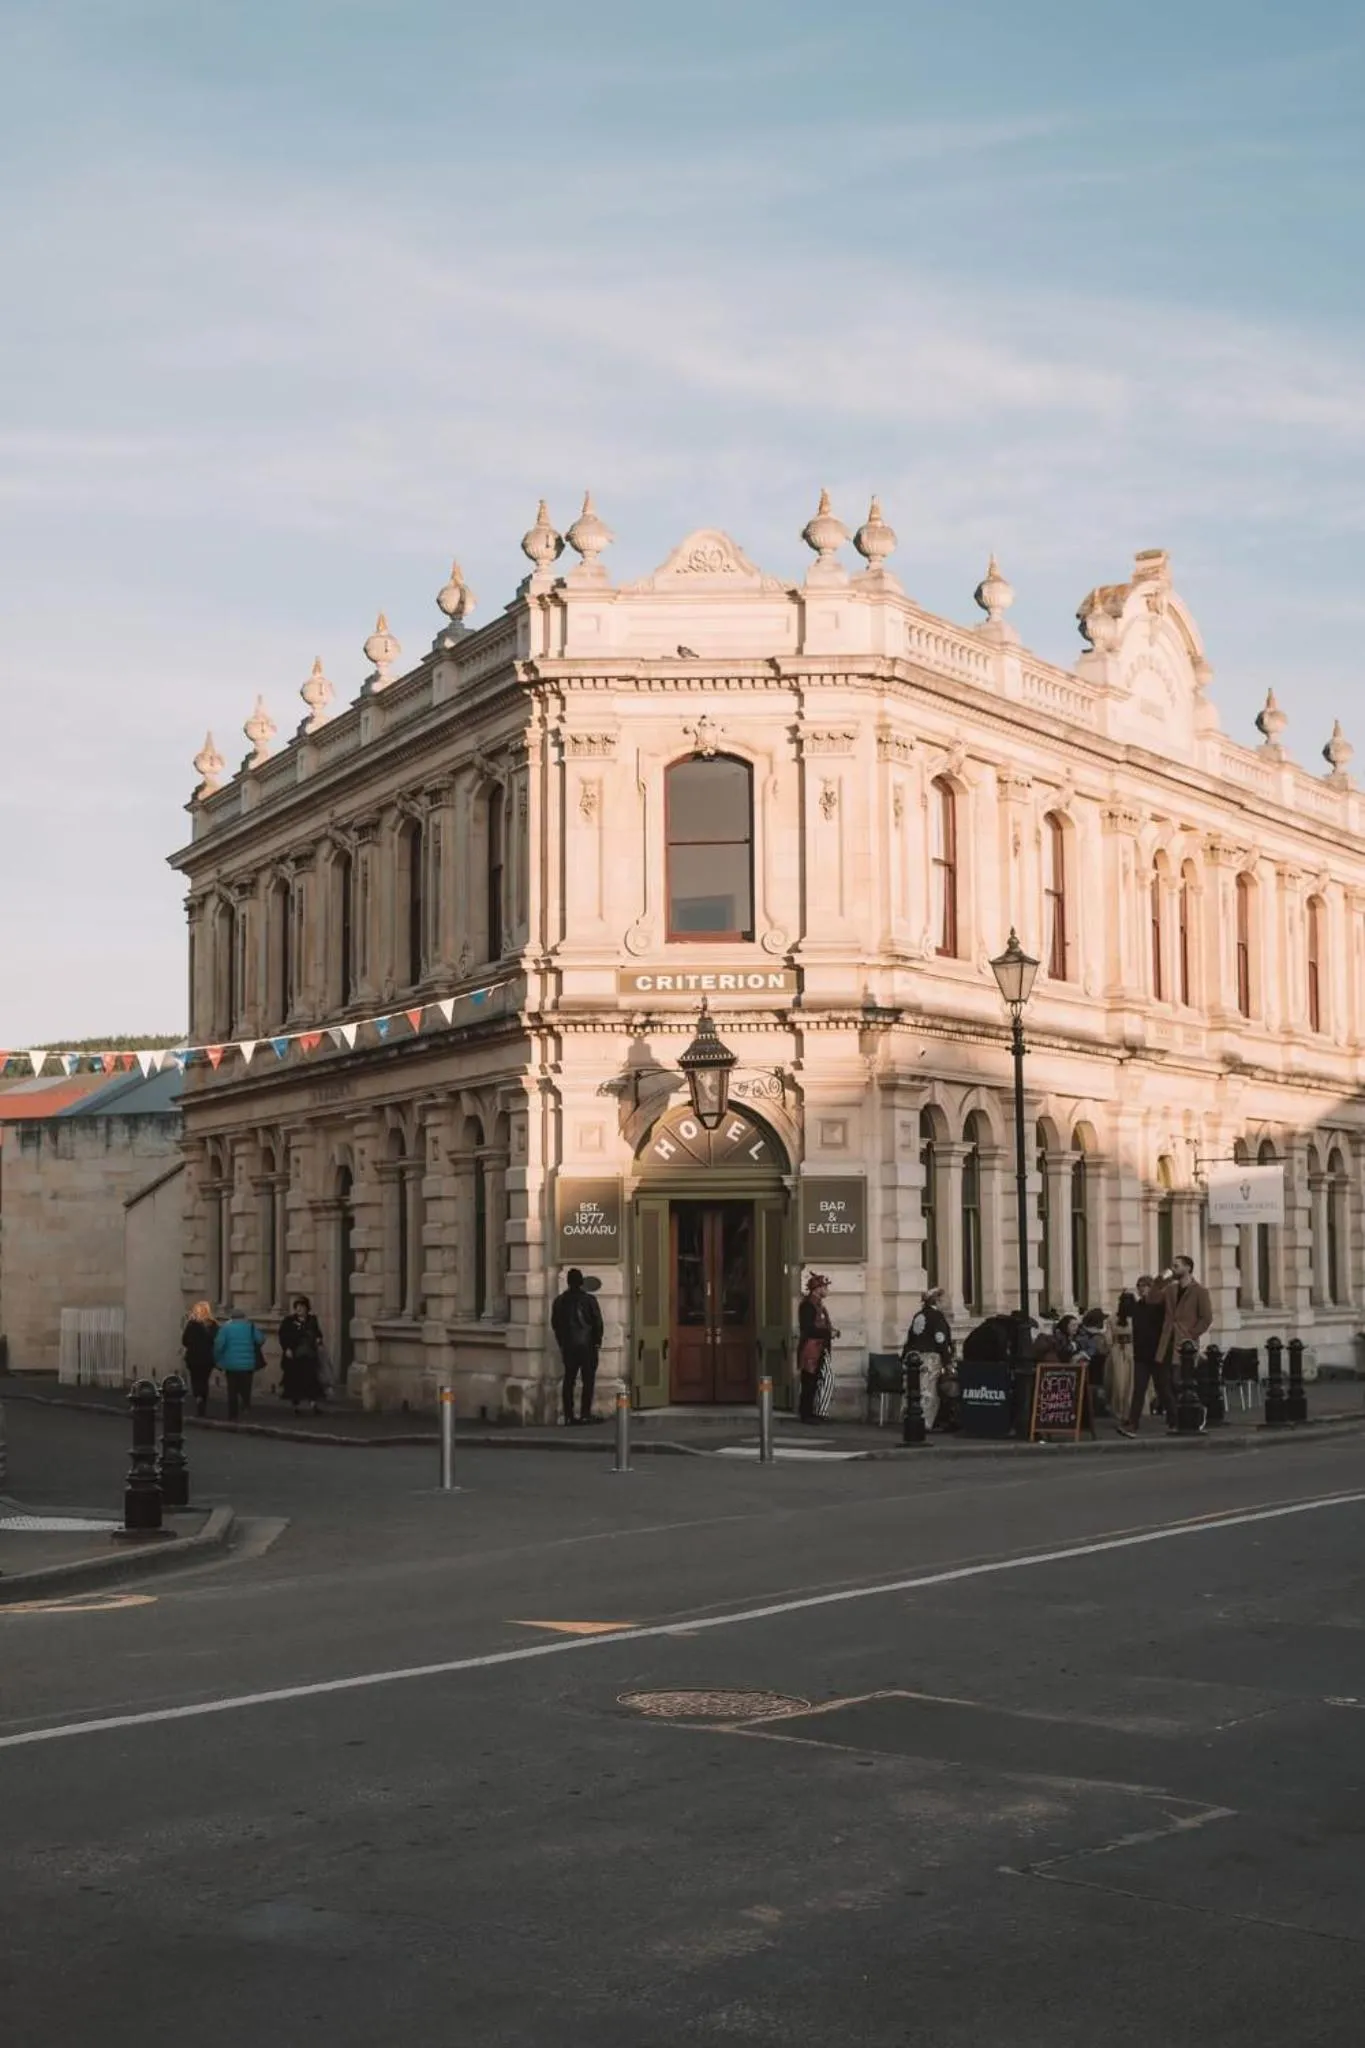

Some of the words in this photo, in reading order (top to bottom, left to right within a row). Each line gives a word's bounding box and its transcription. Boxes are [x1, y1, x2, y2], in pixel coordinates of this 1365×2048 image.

[635, 974, 786, 990] CRITERION
[654, 1120, 766, 1161] HOEL
[579, 1202, 600, 1212] EST.
[819, 1201, 847, 1212] BAR
[575, 1212, 605, 1225] 1877
[828, 1212, 837, 1222] &
[563, 1225, 617, 1236] OAMARU
[808, 1223, 857, 1234] EATERY
